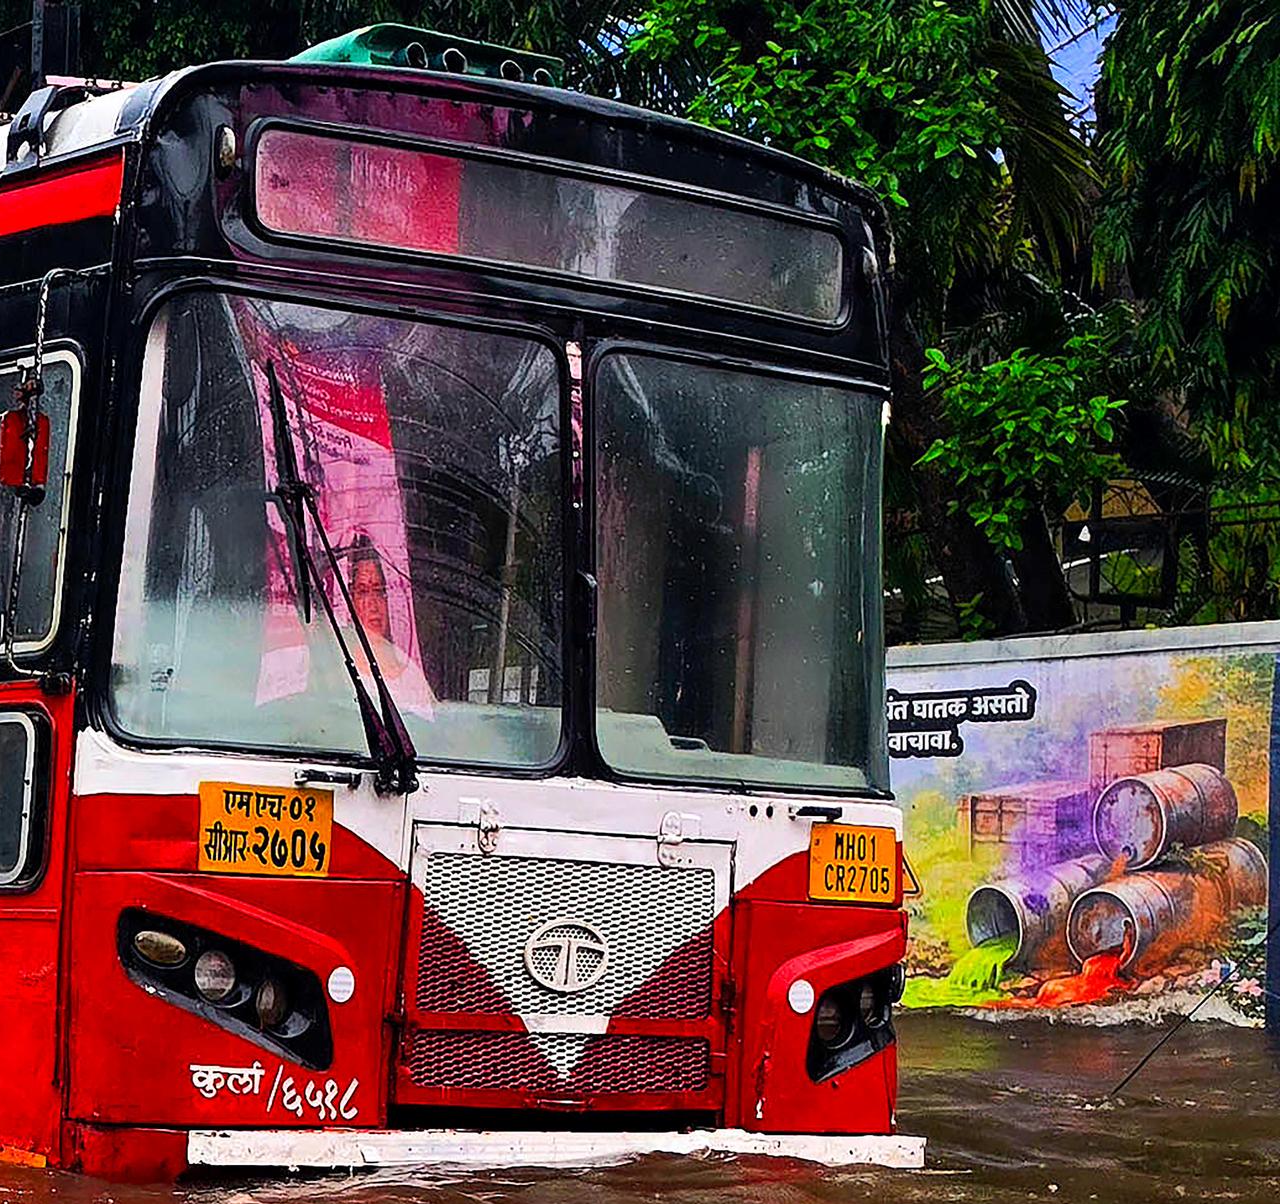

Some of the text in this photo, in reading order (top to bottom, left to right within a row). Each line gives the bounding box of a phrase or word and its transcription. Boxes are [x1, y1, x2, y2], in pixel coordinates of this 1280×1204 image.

[912, 697, 969, 718] घातक
[972, 687, 1030, 716] असतो
[834, 832, 877, 862] MH01
[824, 864, 890, 894] CR2705
